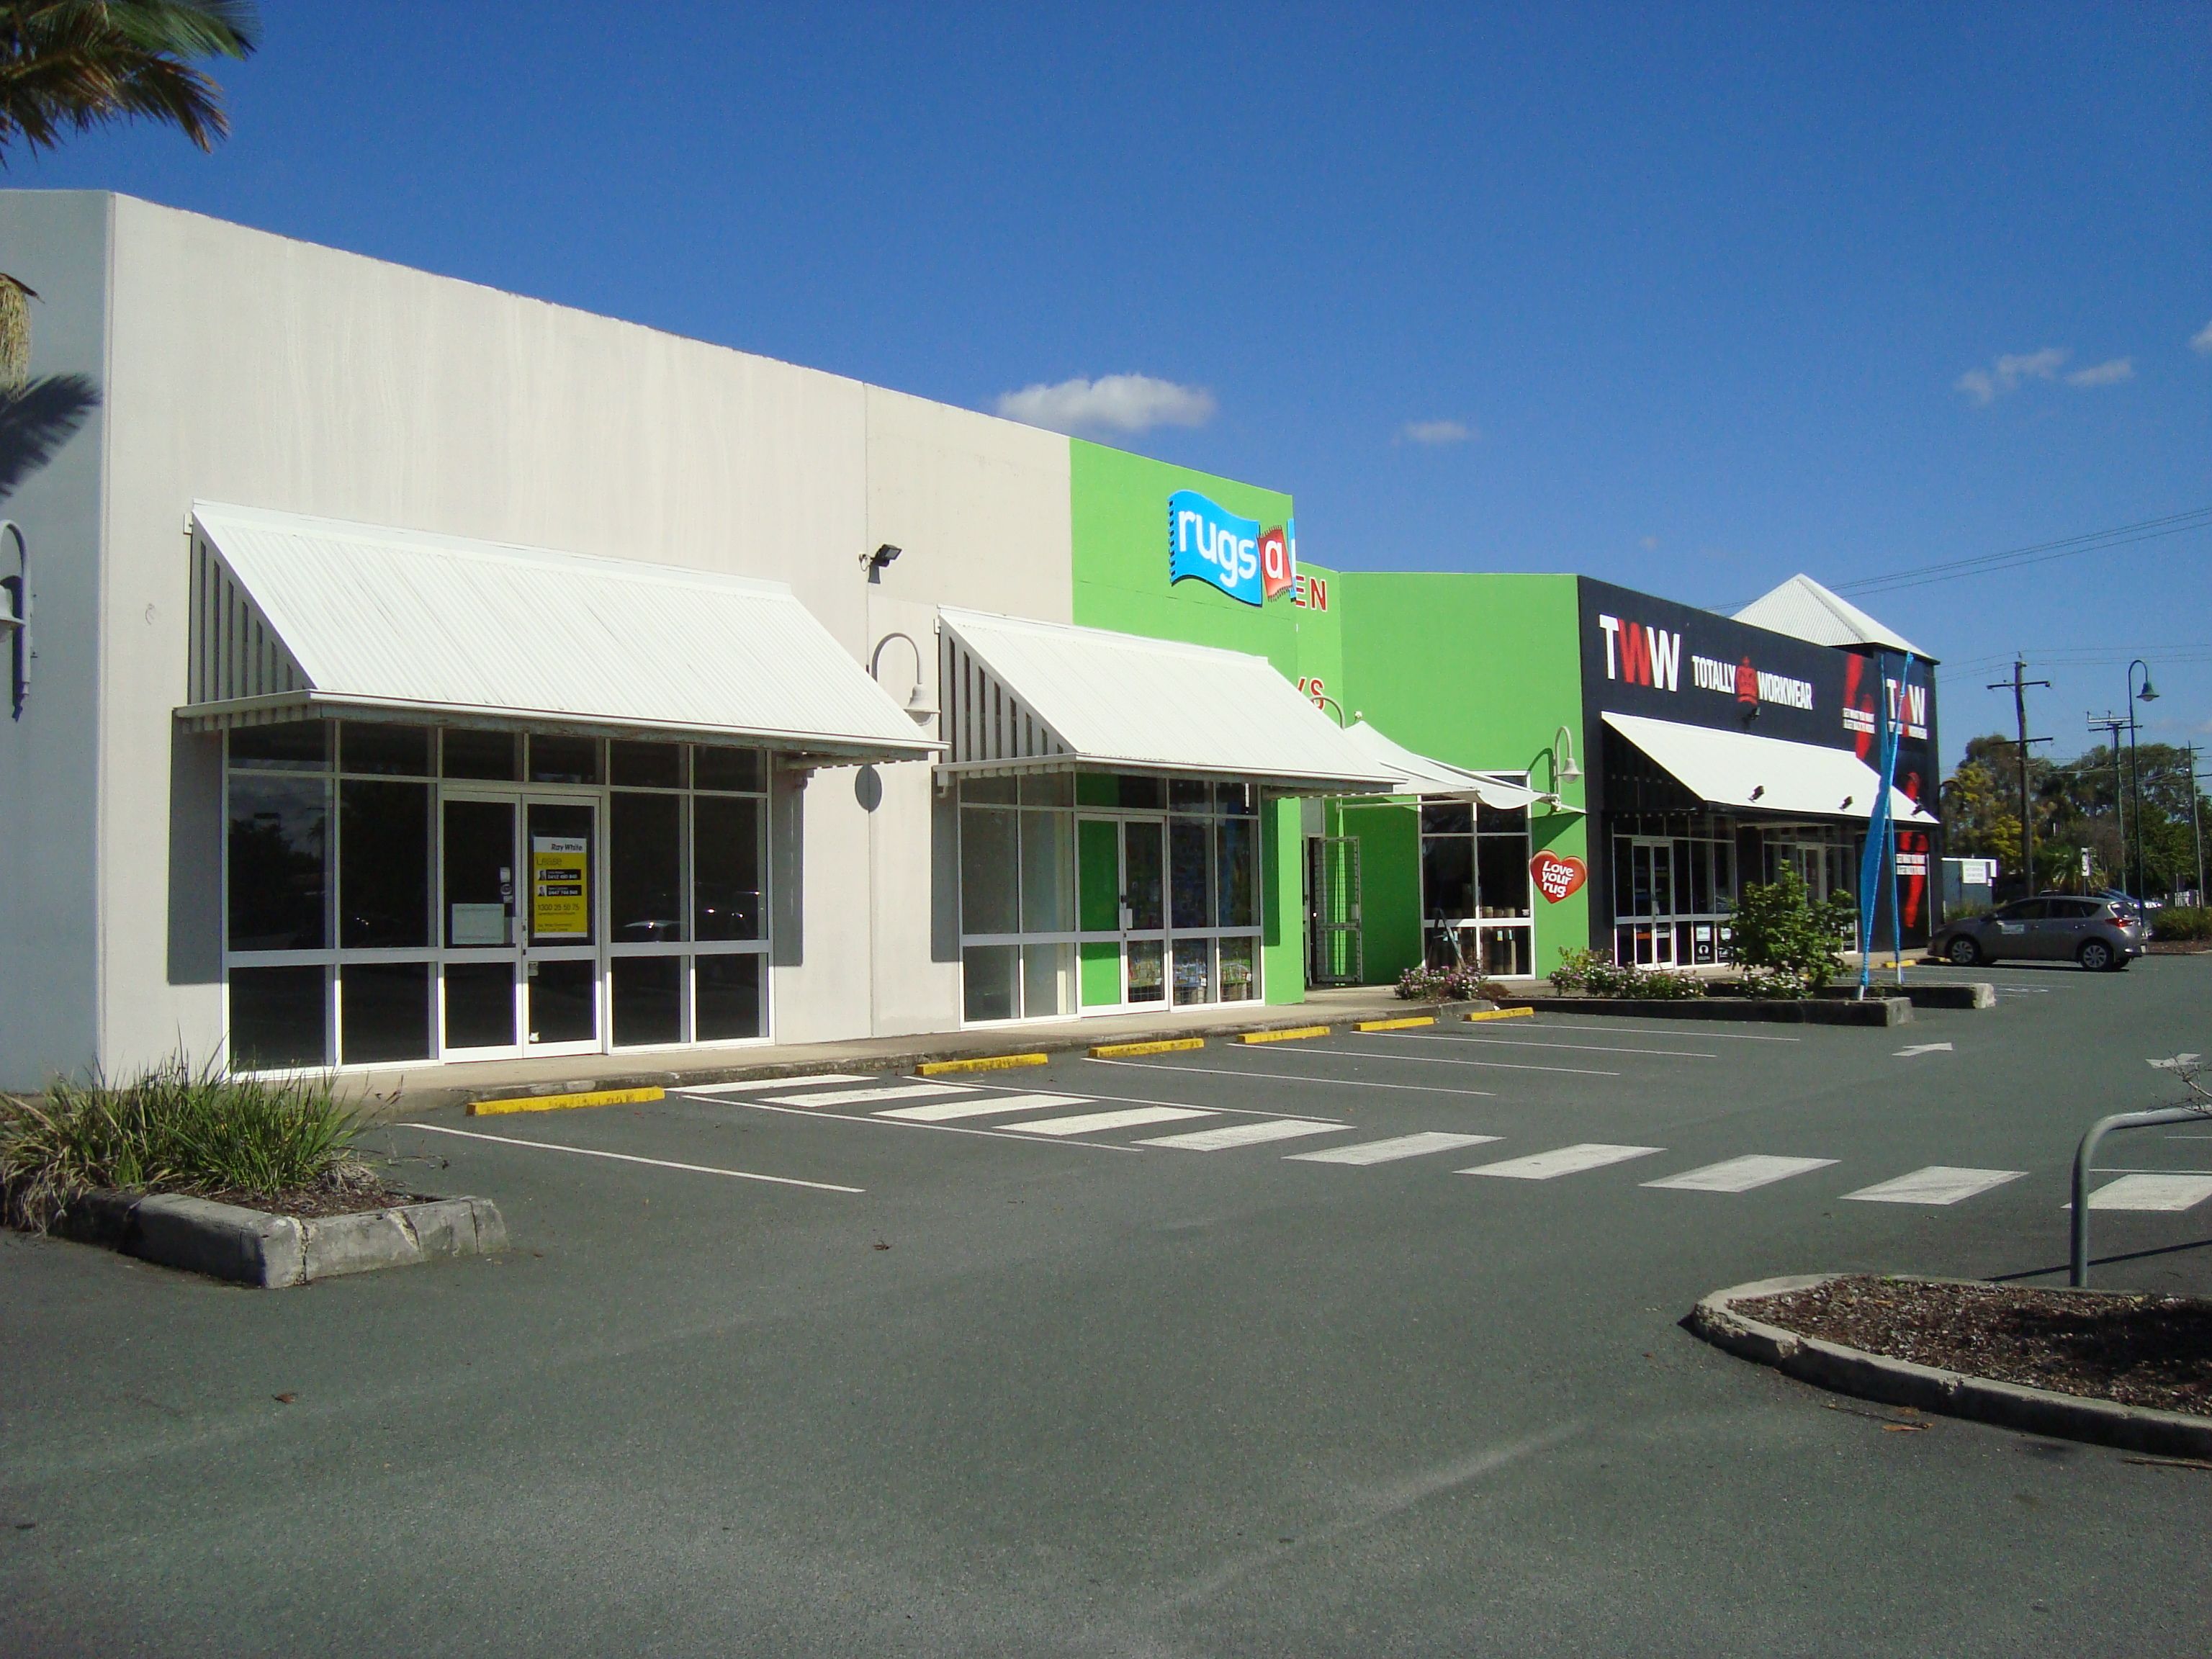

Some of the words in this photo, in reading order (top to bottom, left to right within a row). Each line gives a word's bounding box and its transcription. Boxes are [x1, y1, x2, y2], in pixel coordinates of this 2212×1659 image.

[1178, 510, 1258, 588] rugs
[1599, 613, 1681, 693] TWW
[1691, 655, 1737, 694] TOTALLY
[1756, 670, 1814, 711] WORKWEAR
[551, 843, 563, 852] Ray
[1542, 860, 1575, 877] Love
[1542, 871, 1572, 886] your
[1543, 882, 1567, 898] rug
